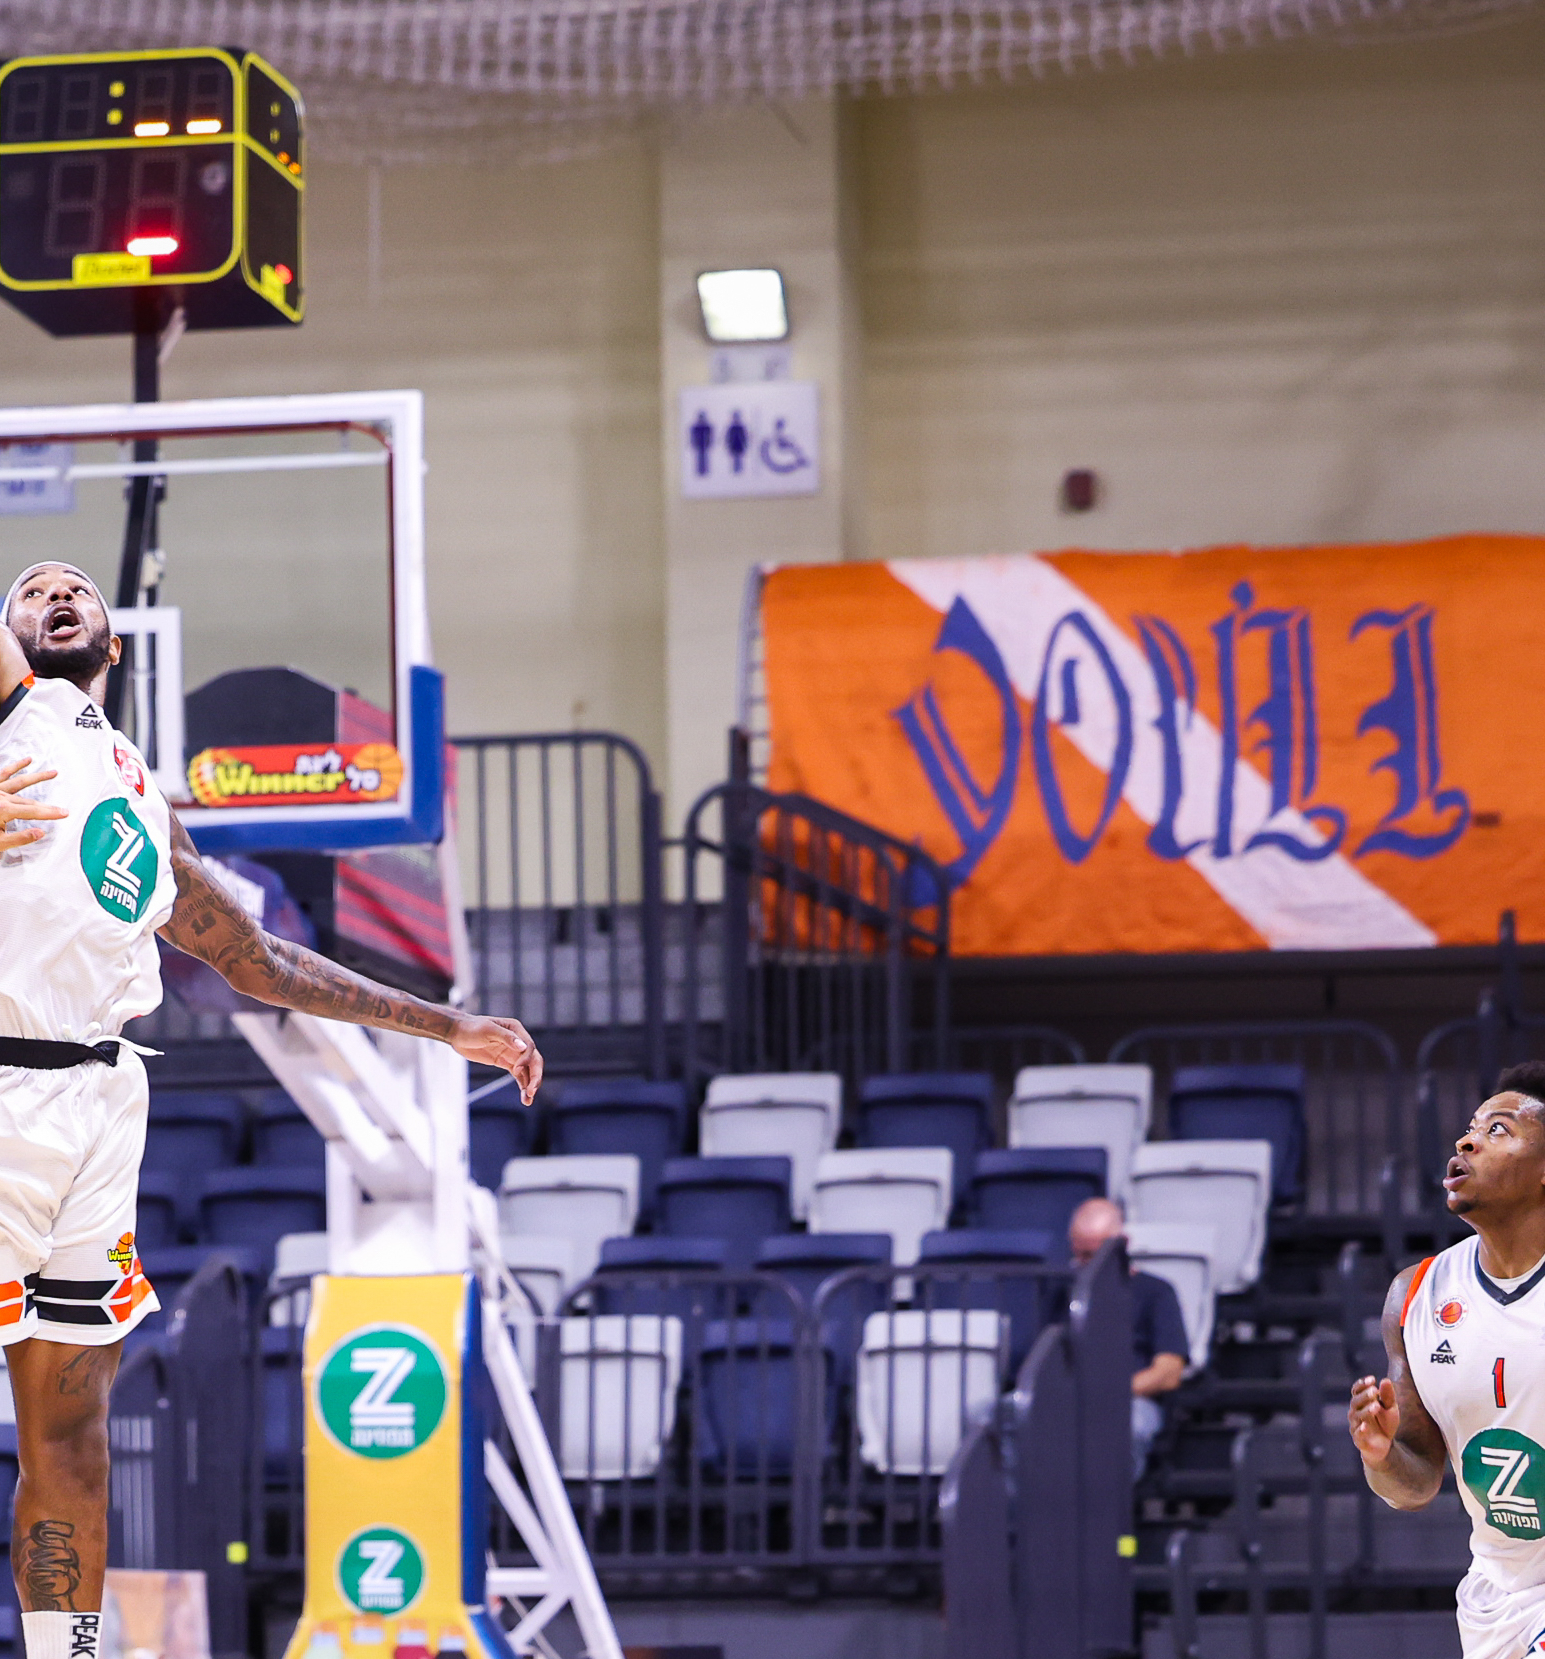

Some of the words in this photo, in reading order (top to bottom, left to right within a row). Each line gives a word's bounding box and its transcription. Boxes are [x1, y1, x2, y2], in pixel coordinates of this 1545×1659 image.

[75, 716, 103, 730] PEAK
[215, 763, 346, 797] Winner
[1430, 1353, 1457, 1365] PEAK
[1491, 1356, 1507, 1409] 1
[1491, 1512, 1541, 1531] תפוזינה
[71, 1614, 100, 1659] PEAK
